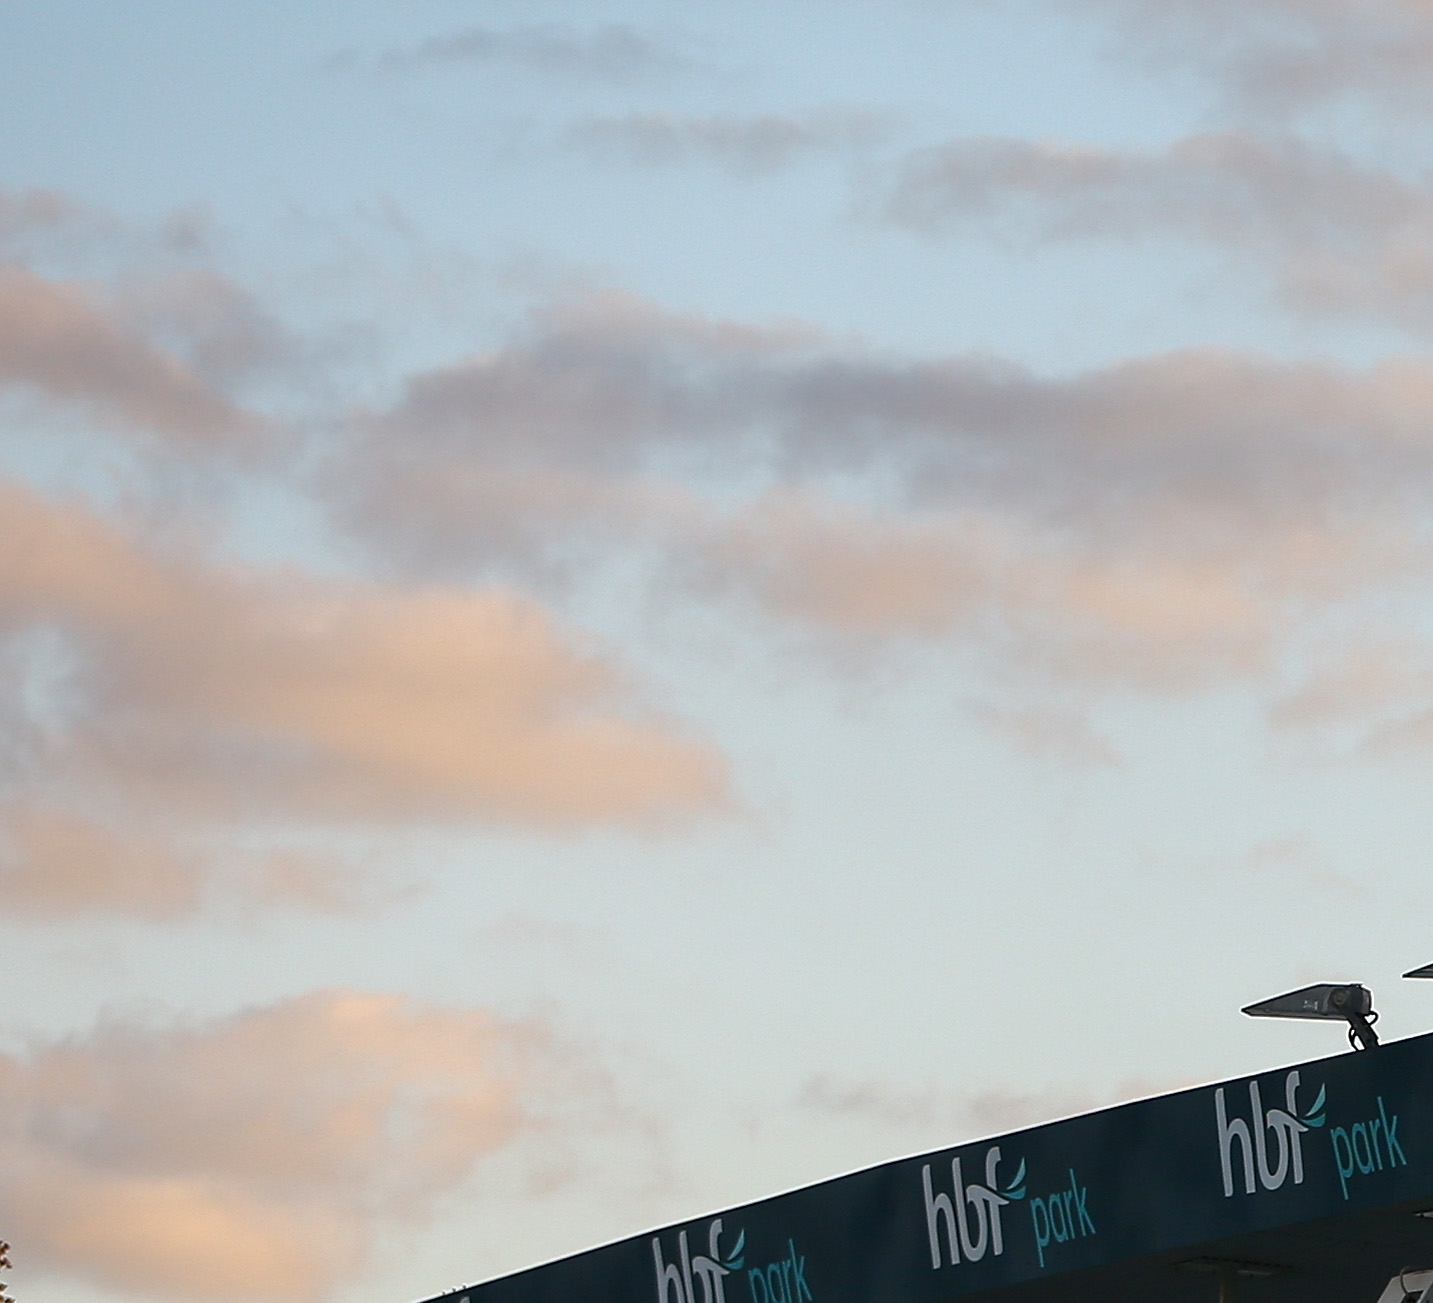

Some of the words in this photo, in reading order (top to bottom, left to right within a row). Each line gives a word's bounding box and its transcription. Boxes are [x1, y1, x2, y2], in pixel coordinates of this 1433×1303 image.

[1215, 1071, 1314, 1198] hbf
[1331, 1108, 1407, 1199] park
[923, 1146, 1010, 1270] hbf
[1031, 1169, 1095, 1267] park
